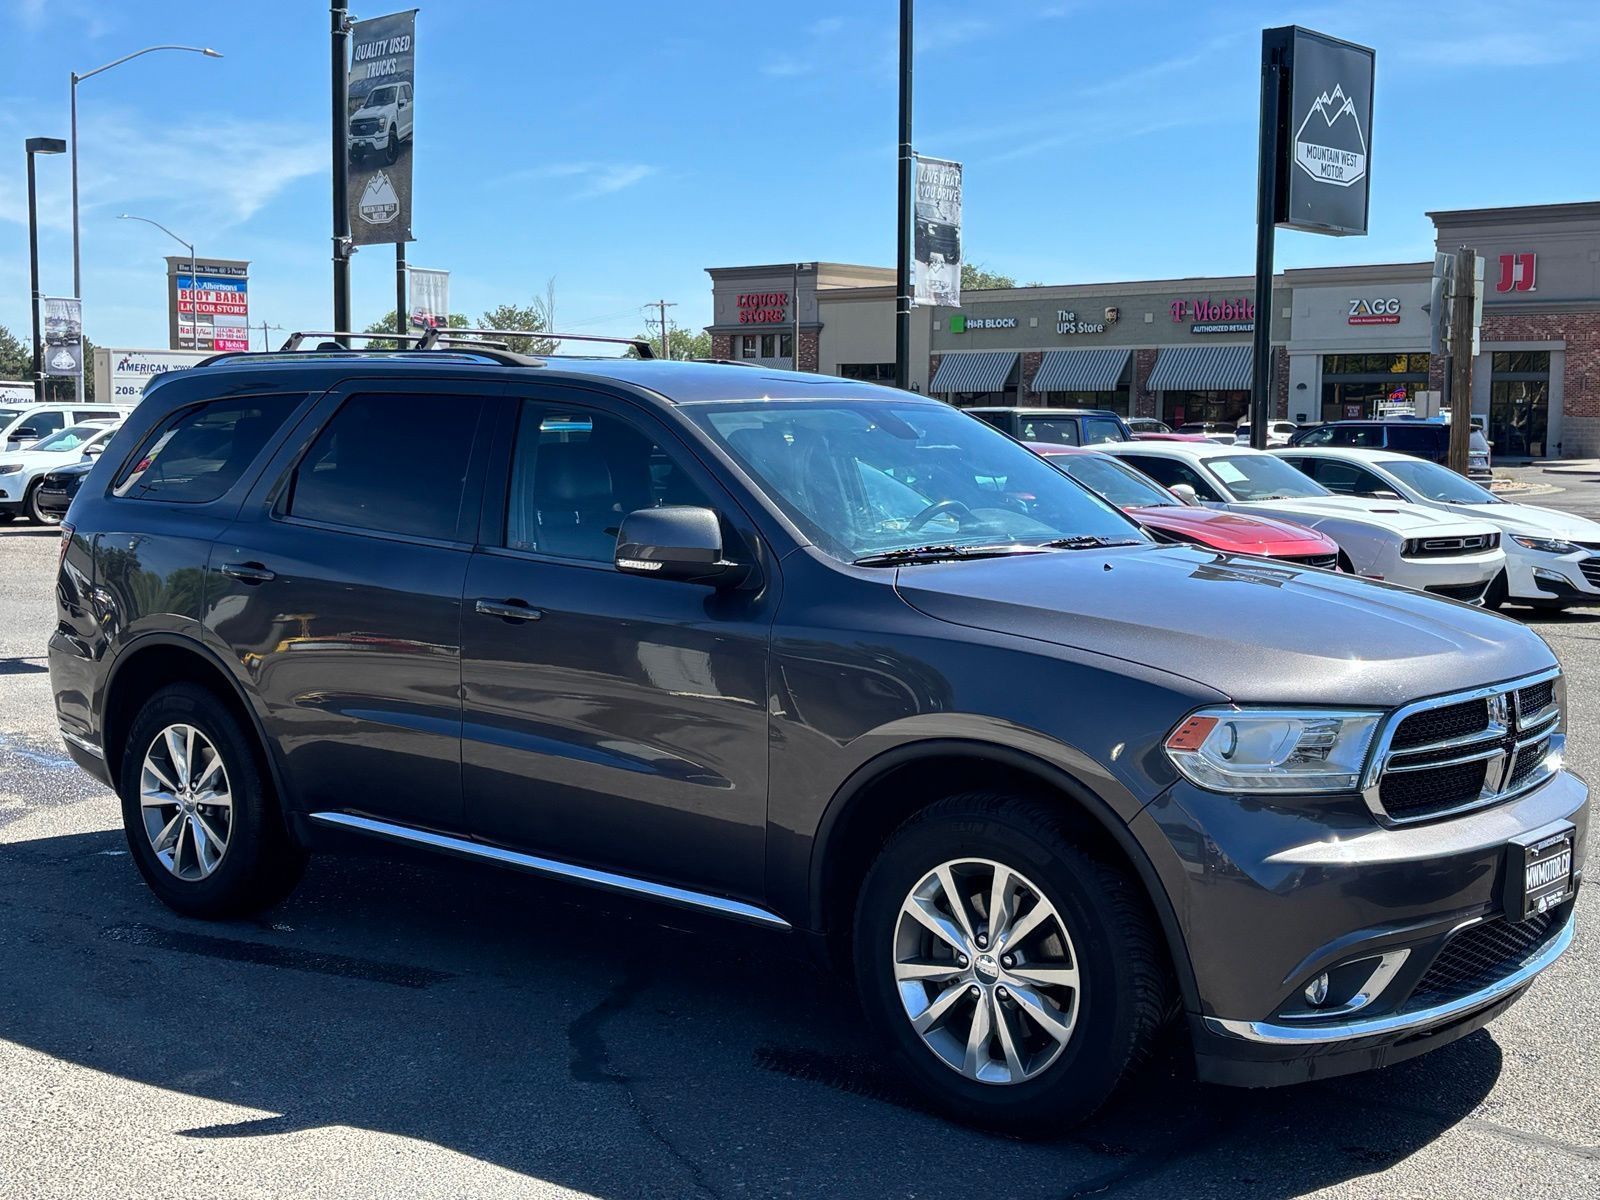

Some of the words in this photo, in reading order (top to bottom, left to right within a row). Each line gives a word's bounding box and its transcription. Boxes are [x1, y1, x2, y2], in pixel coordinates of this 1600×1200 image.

[355, 39, 388, 61] QUALITY
[389, 35, 411, 55] USED
[367, 58, 397, 79] TRUCKS
[1306, 145, 1340, 163] MOUNTAIN
[1341, 152, 1357, 168] WEST
[920, 169, 938, 184] LOVE
[939, 171, 960, 187] WHAT
[1321, 163, 1343, 179] MOTOR
[920, 184, 936, 199] YOU
[937, 187, 959, 202] DRIVE
[202, 282, 237, 291] Albertsons
[180, 289, 211, 301] BOOT
[215, 291, 245, 304] BARN
[736, 293, 786, 309] LIQUOR
[217, 304, 247, 315] STORE
[1349, 298, 1400, 315] ZAGG
[739, 309, 785, 324] STORE
[1057, 310, 1075, 321] The
[967, 319, 984, 329] H&R
[985, 318, 1016, 328] BLOCK
[1056, 322, 1076, 334] UPS
[1077, 321, 1104, 334] Store
[1193, 325, 1229, 333] AUTHORIZED
[117, 360, 169, 373] AMERICAN
